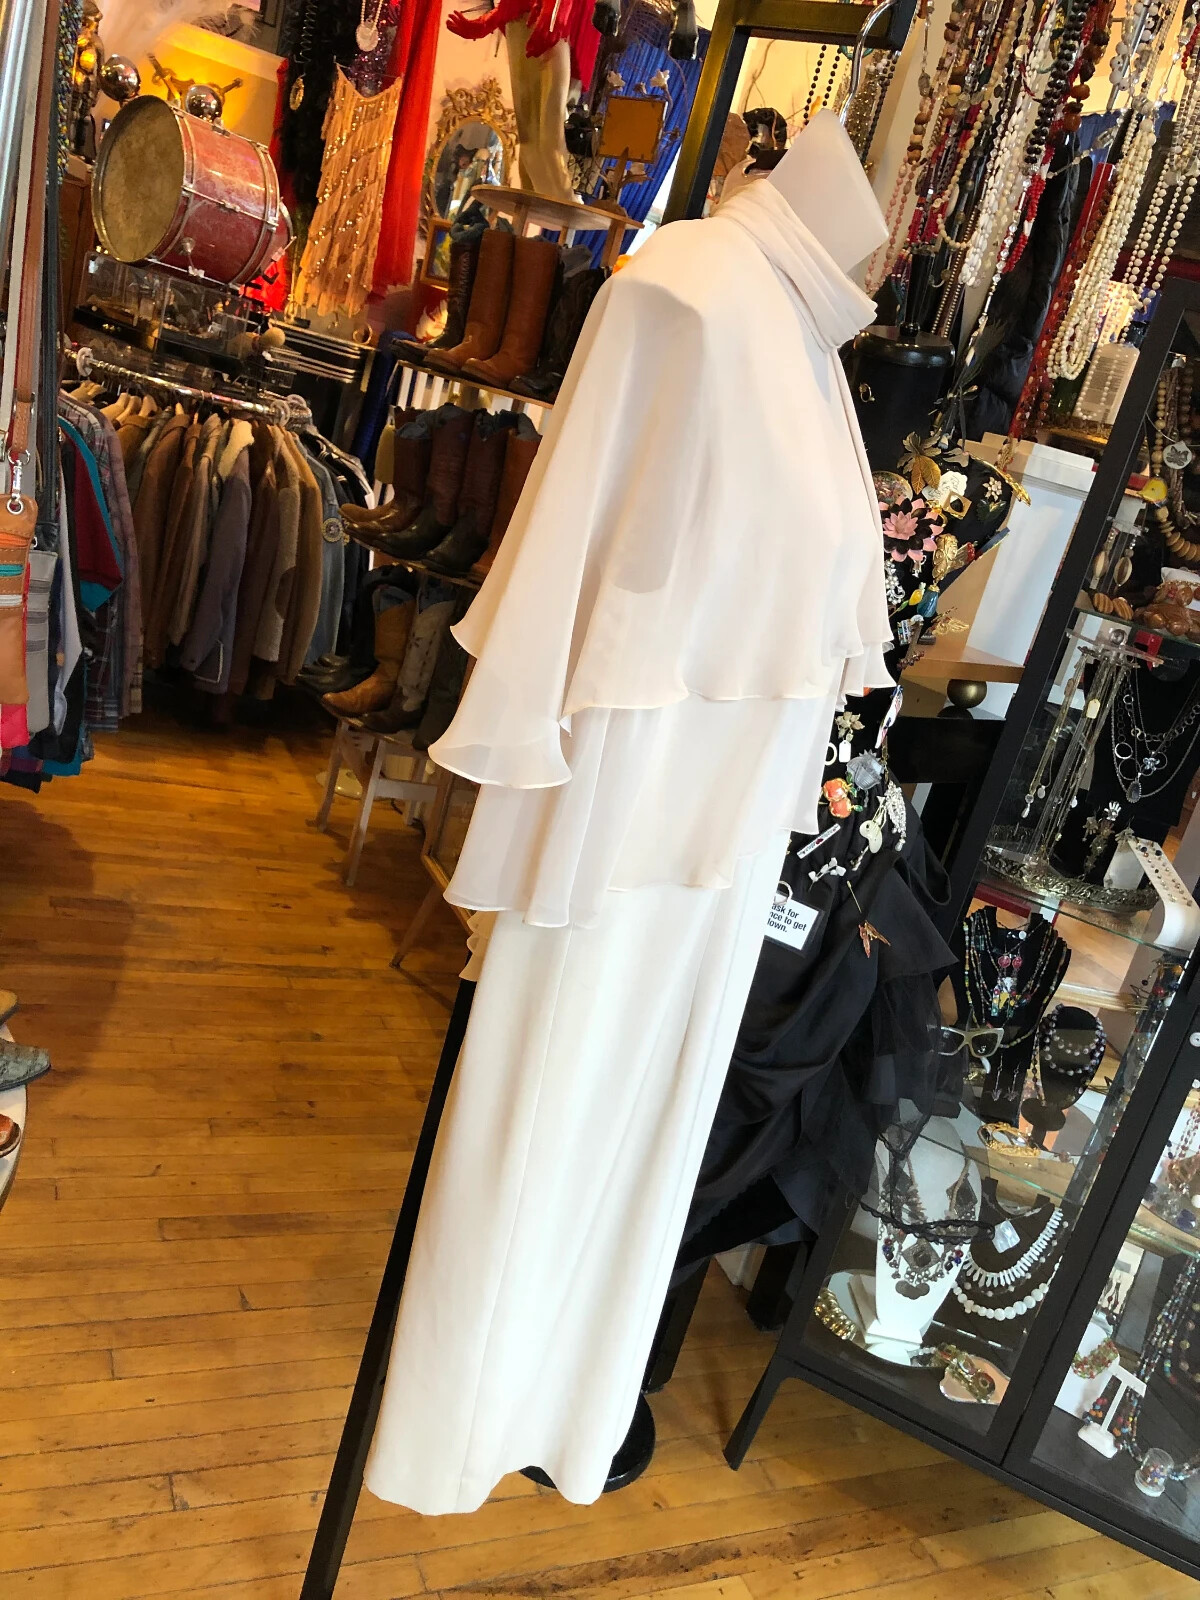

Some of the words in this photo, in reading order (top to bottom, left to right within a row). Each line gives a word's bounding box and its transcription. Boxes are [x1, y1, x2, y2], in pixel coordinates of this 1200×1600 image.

[787, 908, 799, 919] for
[784, 916, 792, 925] to
[792, 921, 807, 932] get
